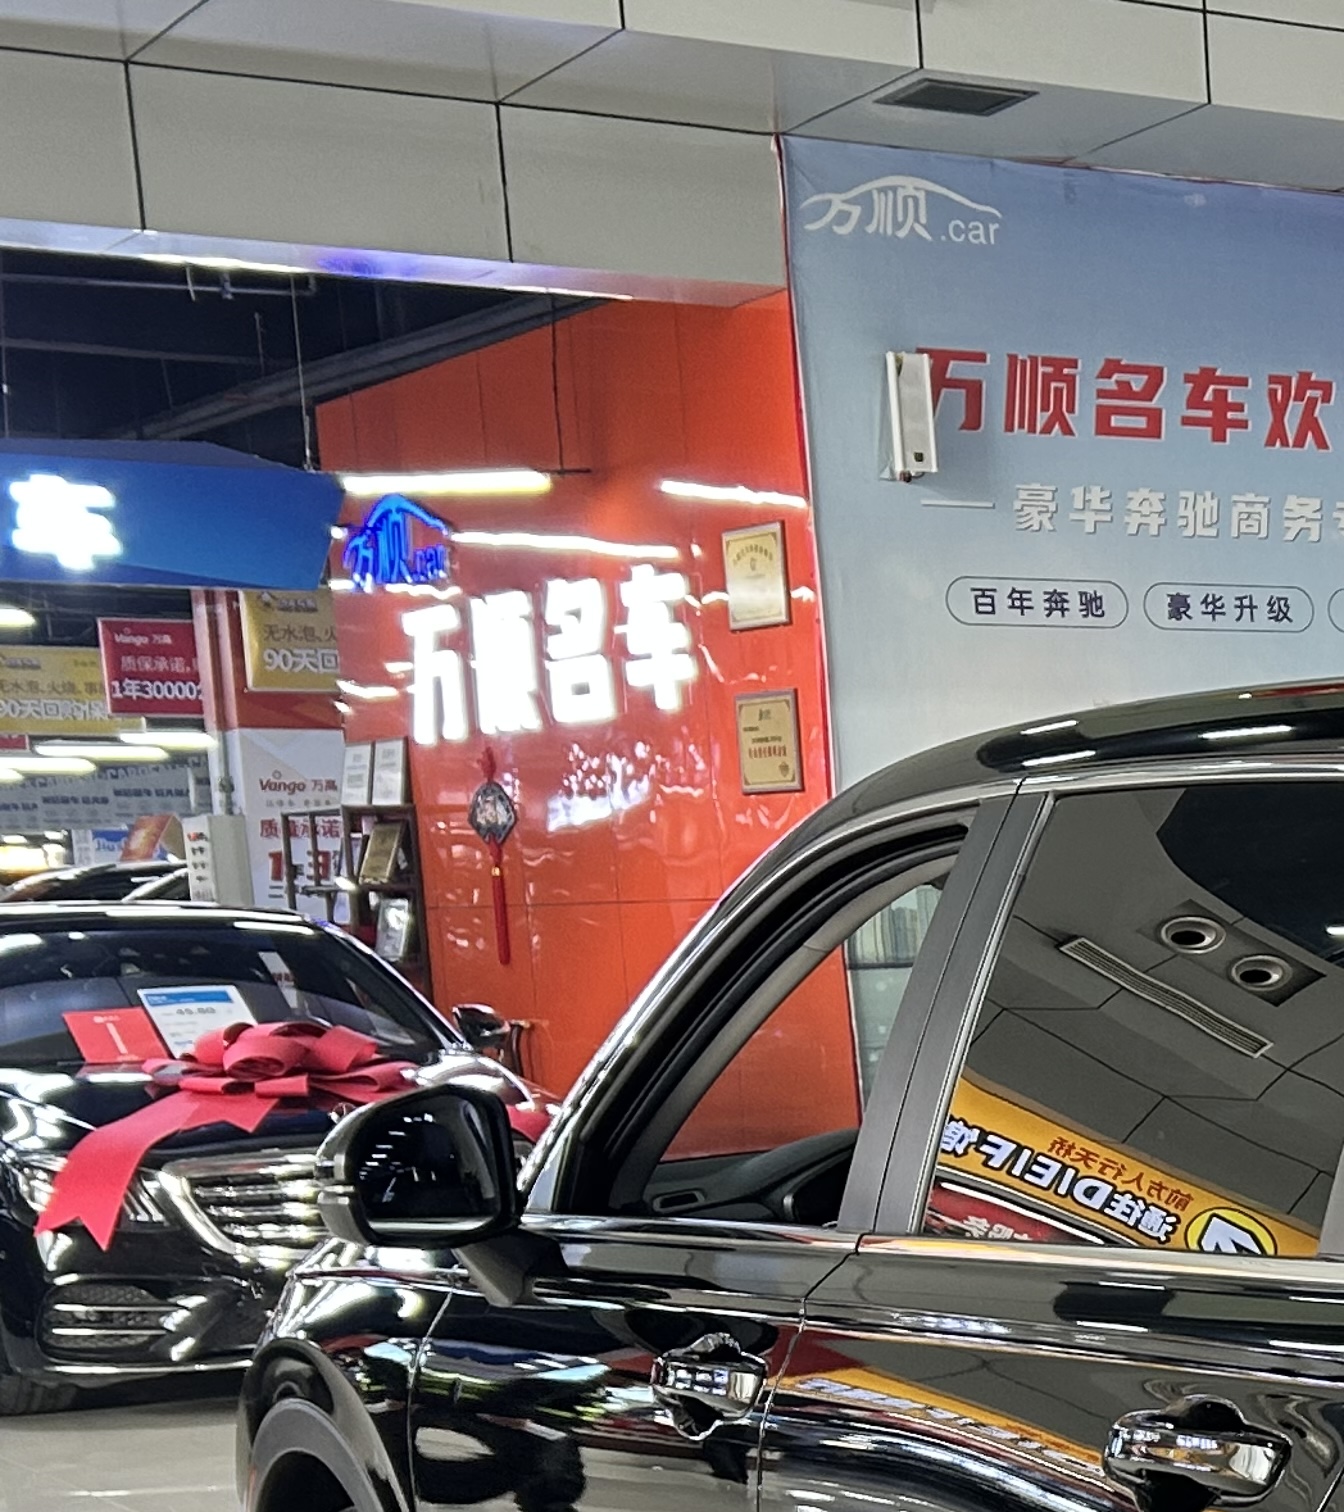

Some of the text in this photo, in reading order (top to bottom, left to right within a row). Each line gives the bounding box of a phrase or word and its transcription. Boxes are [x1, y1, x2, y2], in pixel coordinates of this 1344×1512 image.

[940, 219, 1000, 245] .car
[970, 587, 1107, 618] 百年奔驰
[1166, 592, 1294, 624] 豪华升级
[402, 564, 696, 745] 万顺名车
[259, 777, 307, 795] Vango
